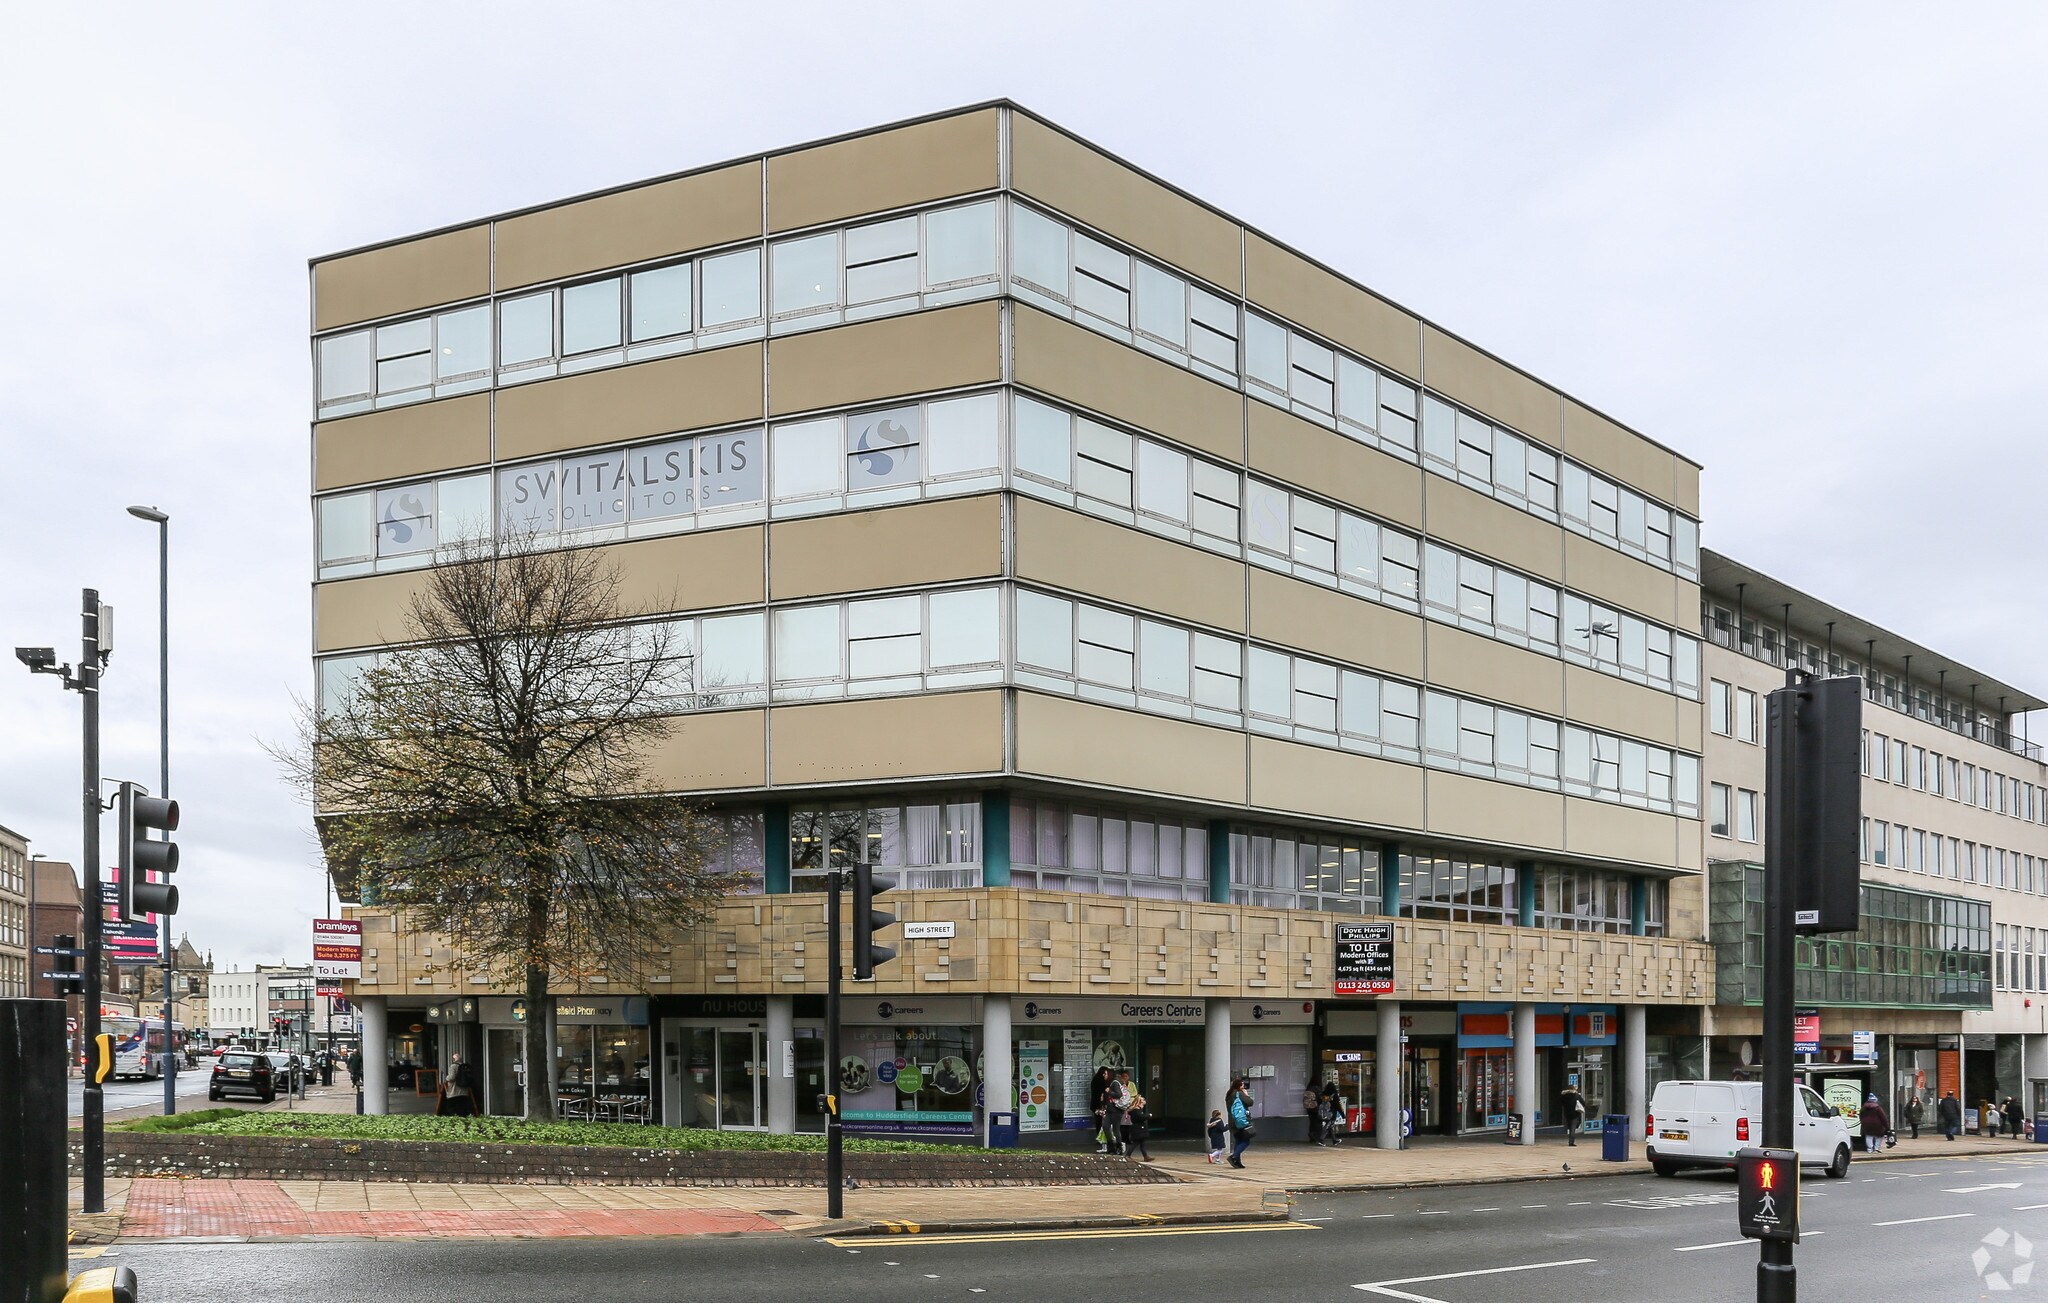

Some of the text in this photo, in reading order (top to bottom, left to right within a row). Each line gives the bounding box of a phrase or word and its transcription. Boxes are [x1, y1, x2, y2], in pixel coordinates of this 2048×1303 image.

[514, 440, 747, 504] SWITALSKIS
[547, 486, 711, 522] SOLICITORS
[317, 922, 357, 932] bramleys
[1350, 944, 1361, 952] TO
[318, 966, 348, 975] To Let
[1357, 981, 1371, 989] 245
[1372, 981, 1391, 989] 0550
[576, 1006, 613, 1017] Pharmacy
[727, 1000, 766, 1013] HOUS
[1038, 1007, 1062, 1015] careers
[1120, 1003, 1202, 1017] Careers Centre
[1794, 1017, 1808, 1026] LET
[853, 1031, 878, 1040] Let's
[882, 1030, 901, 1040] talk
[875, 1111, 919, 1120] Huddersfield
[920, 1112, 947, 1120] Careers
[948, 1113, 973, 1121] Centre
[841, 1123, 900, 1132] w.ckcareersonline.org.uk
